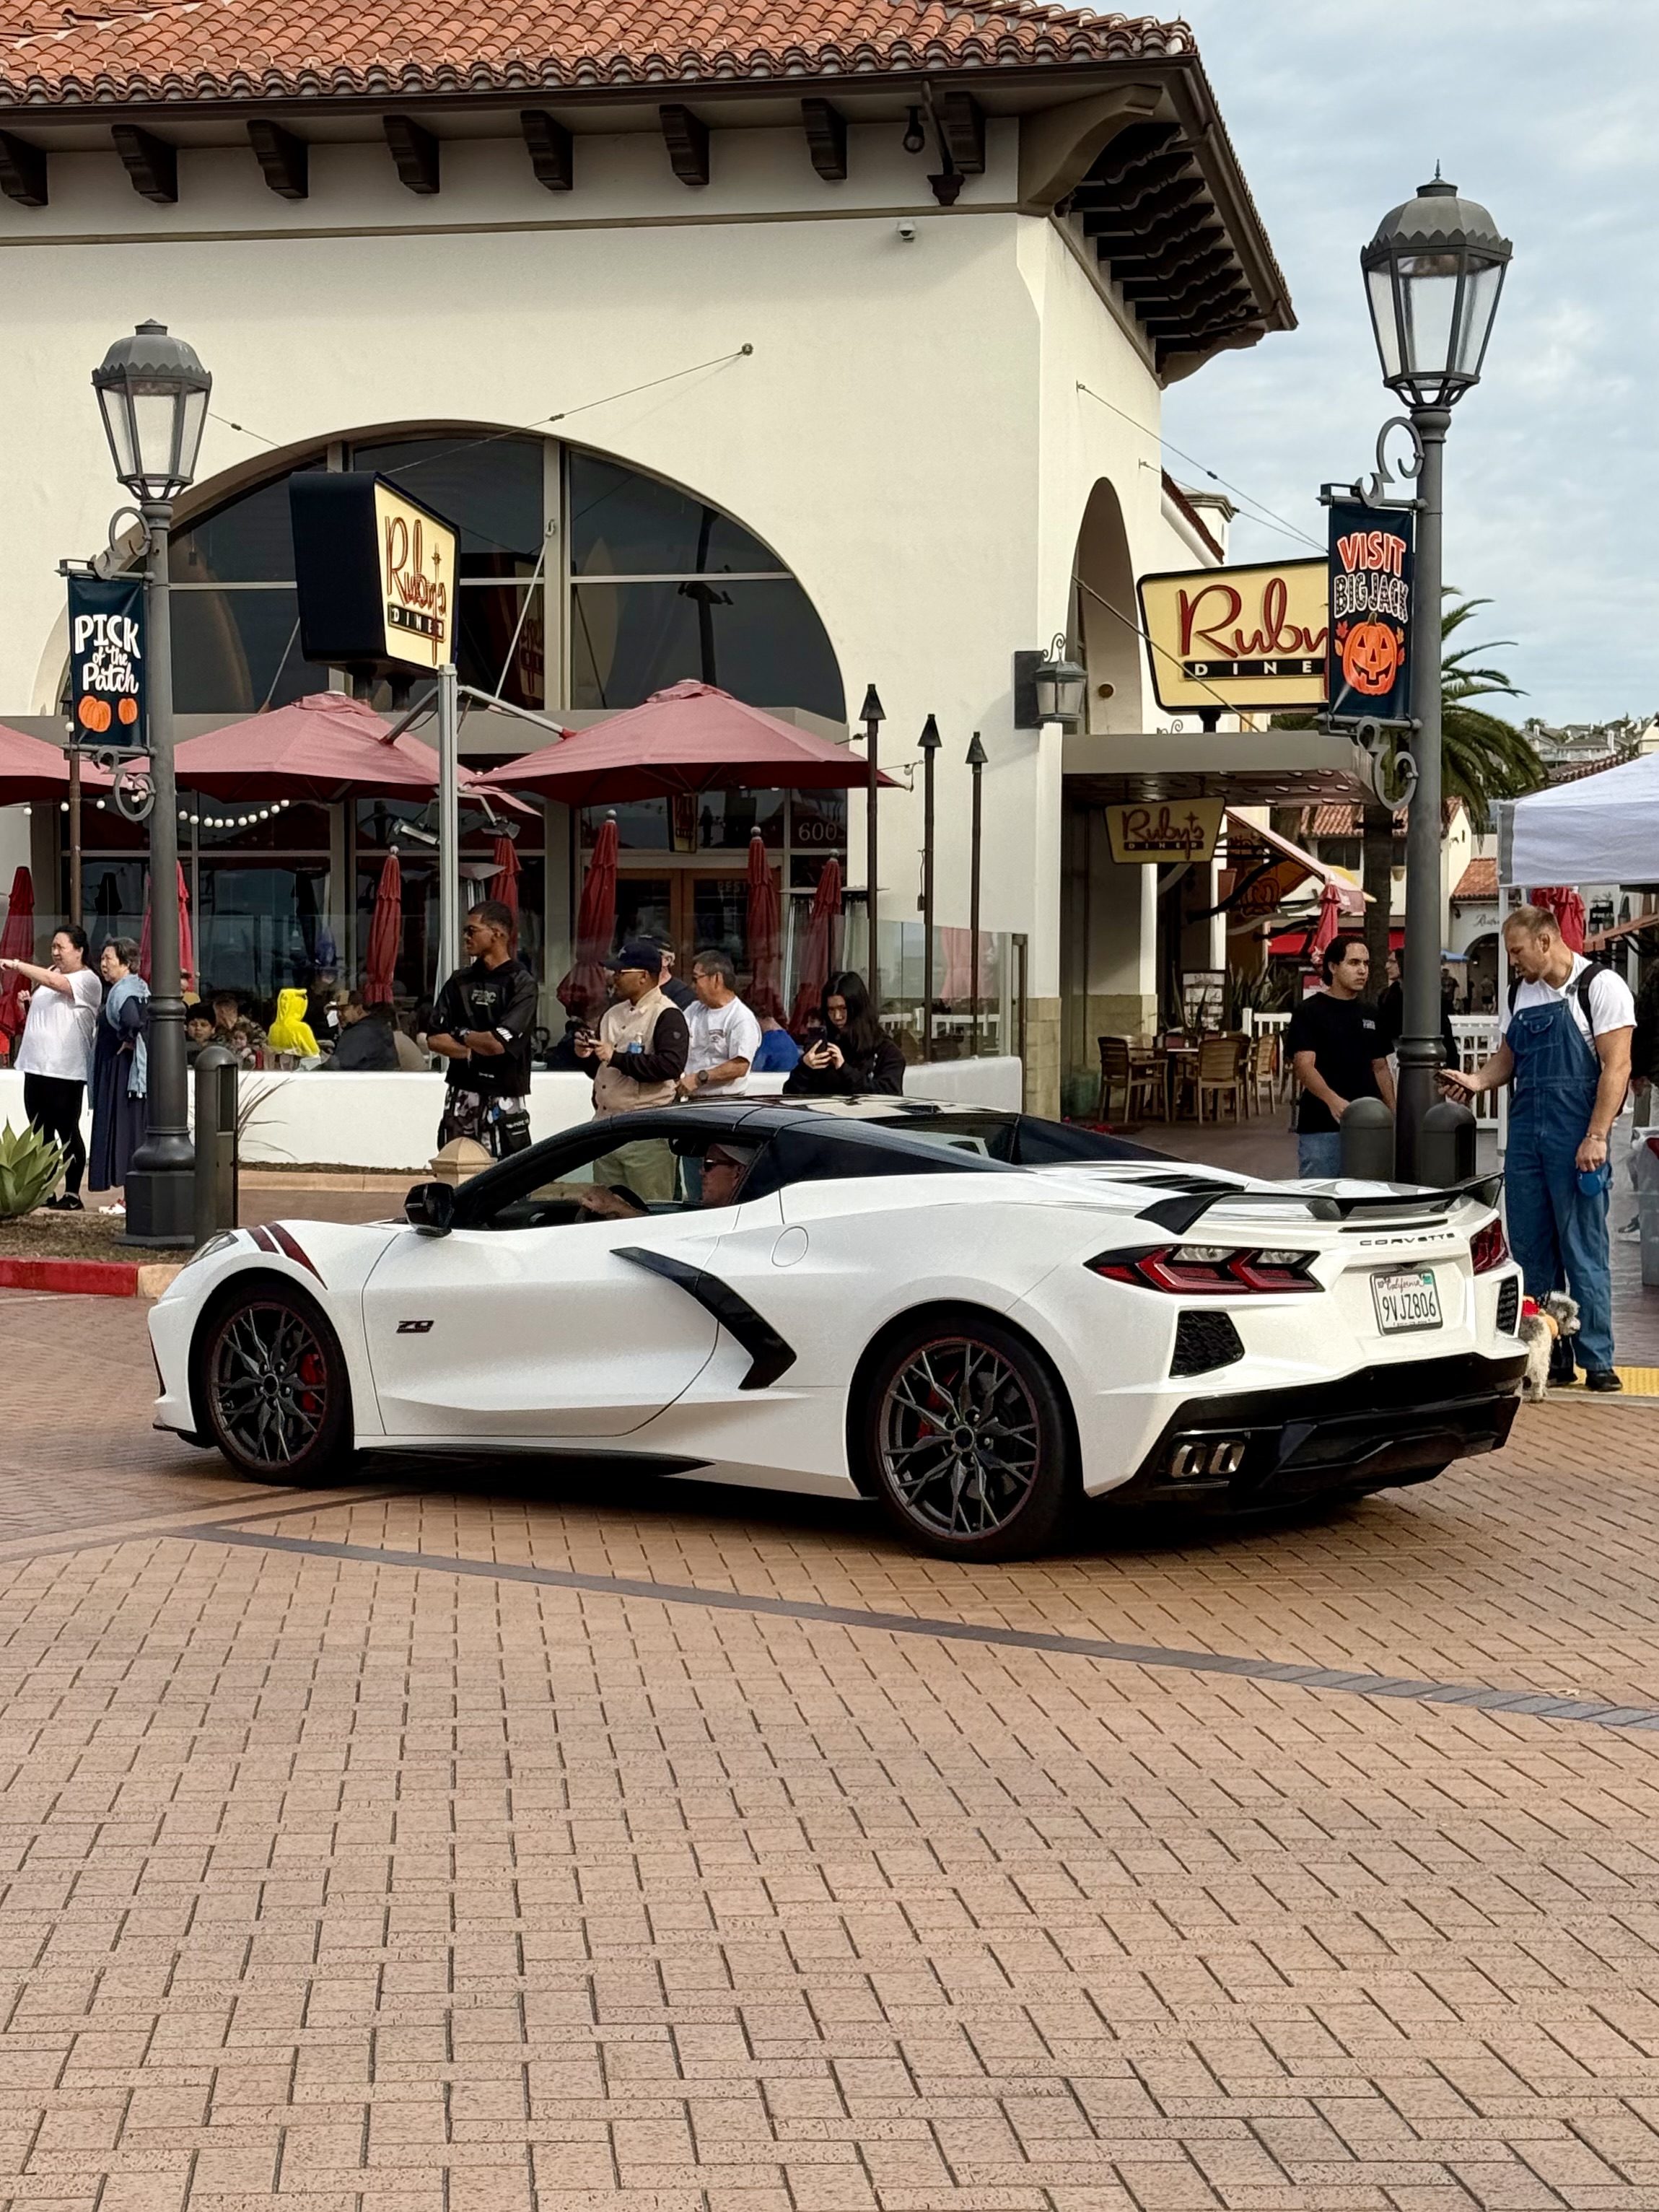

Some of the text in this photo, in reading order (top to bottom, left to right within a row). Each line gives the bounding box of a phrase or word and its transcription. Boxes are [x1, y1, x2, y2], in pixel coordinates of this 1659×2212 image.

[1336, 530, 1406, 577] VISIT
[1334, 572, 1409, 624] BIG JACK
[74, 614, 141, 659] PICK
[391, 608, 443, 637] DINER
[1178, 577, 1329, 700] Ruby
[92, 644, 128, 665] of the
[1194, 660, 1312, 676] DINE
[82, 662, 139, 694] Patch
[799, 823, 837, 841] 600
[1360, 1233, 1456, 1246] CORVETTE
[1382, 1291, 1437, 1321] 9VJZ806
